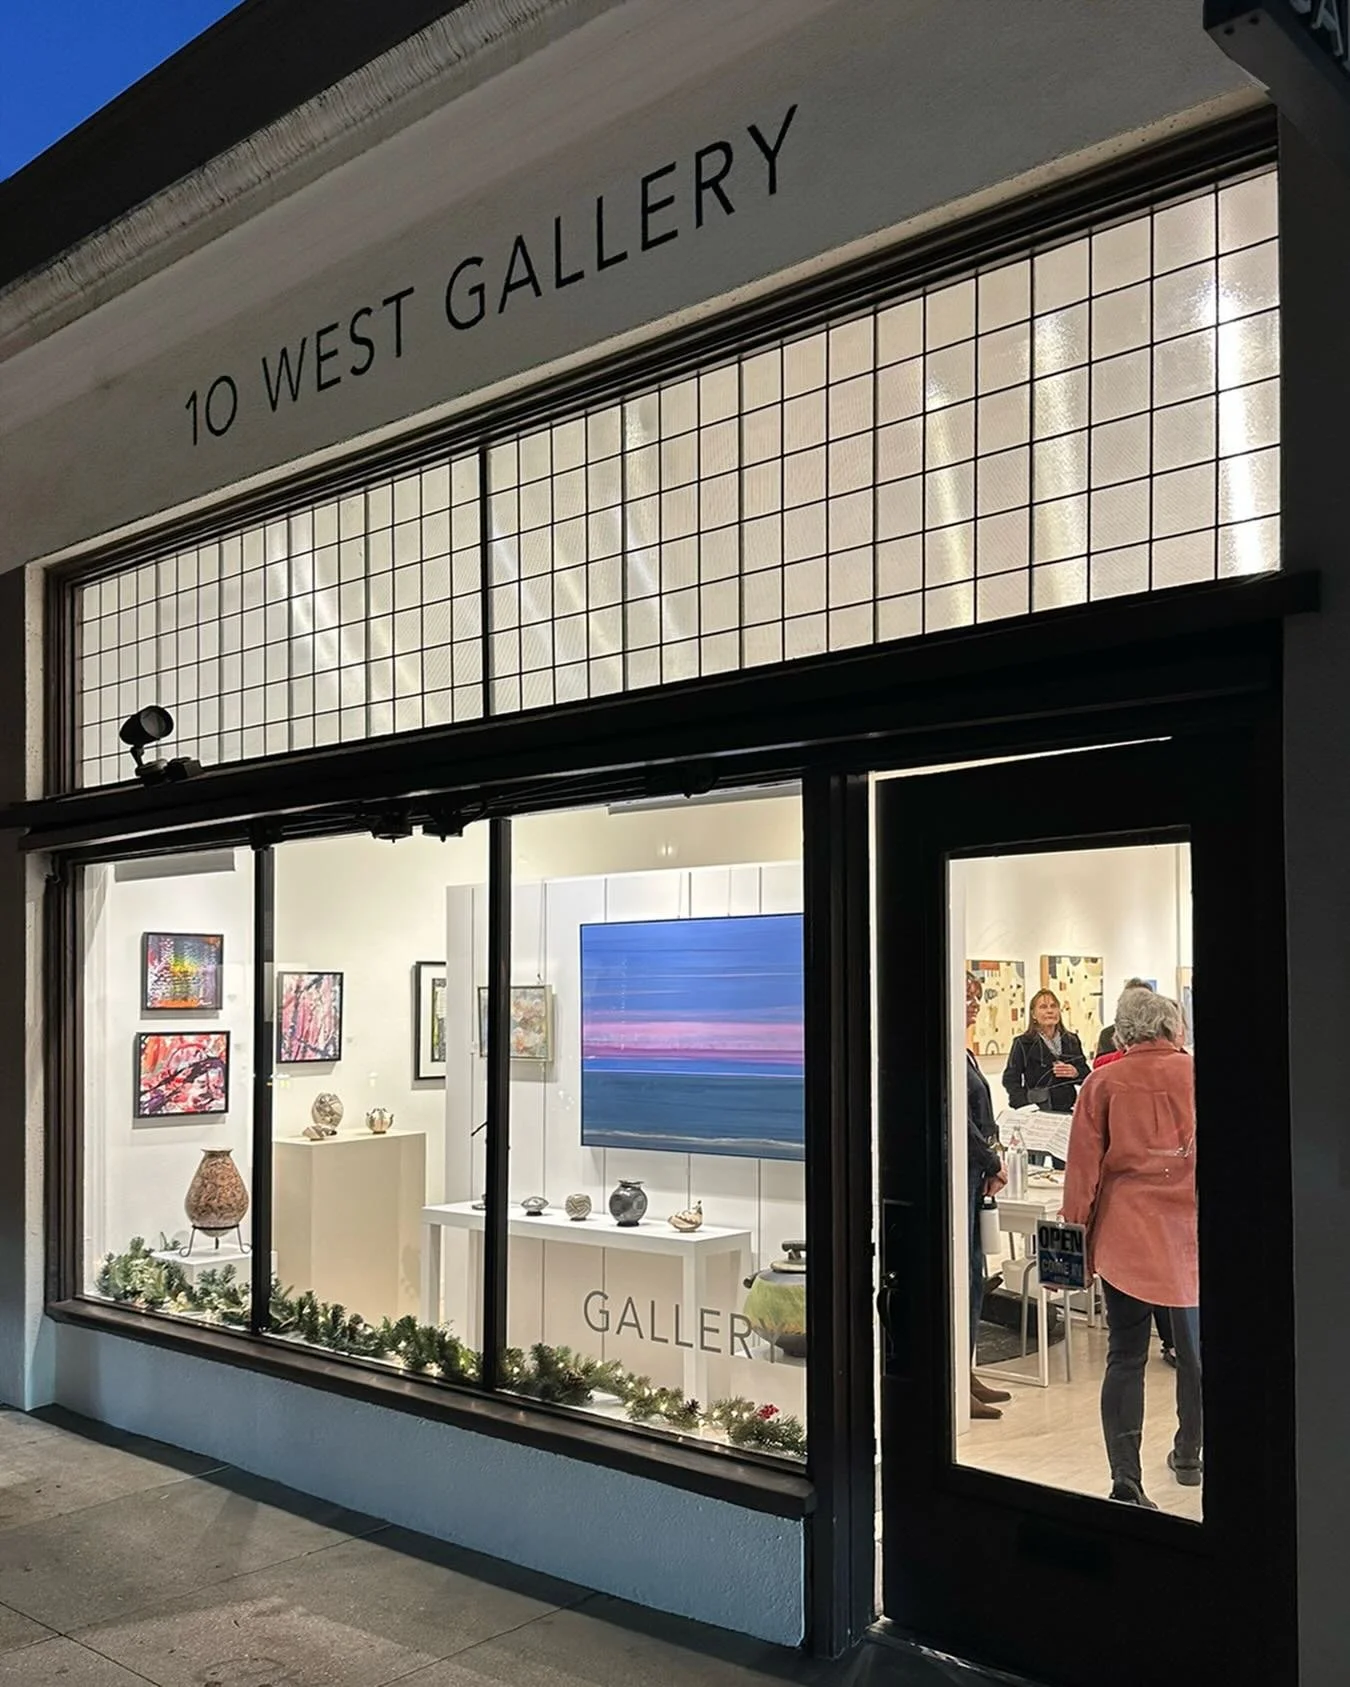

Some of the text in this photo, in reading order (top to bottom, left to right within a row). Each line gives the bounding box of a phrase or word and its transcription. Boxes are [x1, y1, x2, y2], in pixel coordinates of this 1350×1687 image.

[185, 103, 799, 447] 10 WEST GALLERY
[1039, 1226, 1083, 1253] OPEN
[583, 1290, 786, 1364] GALLERY
